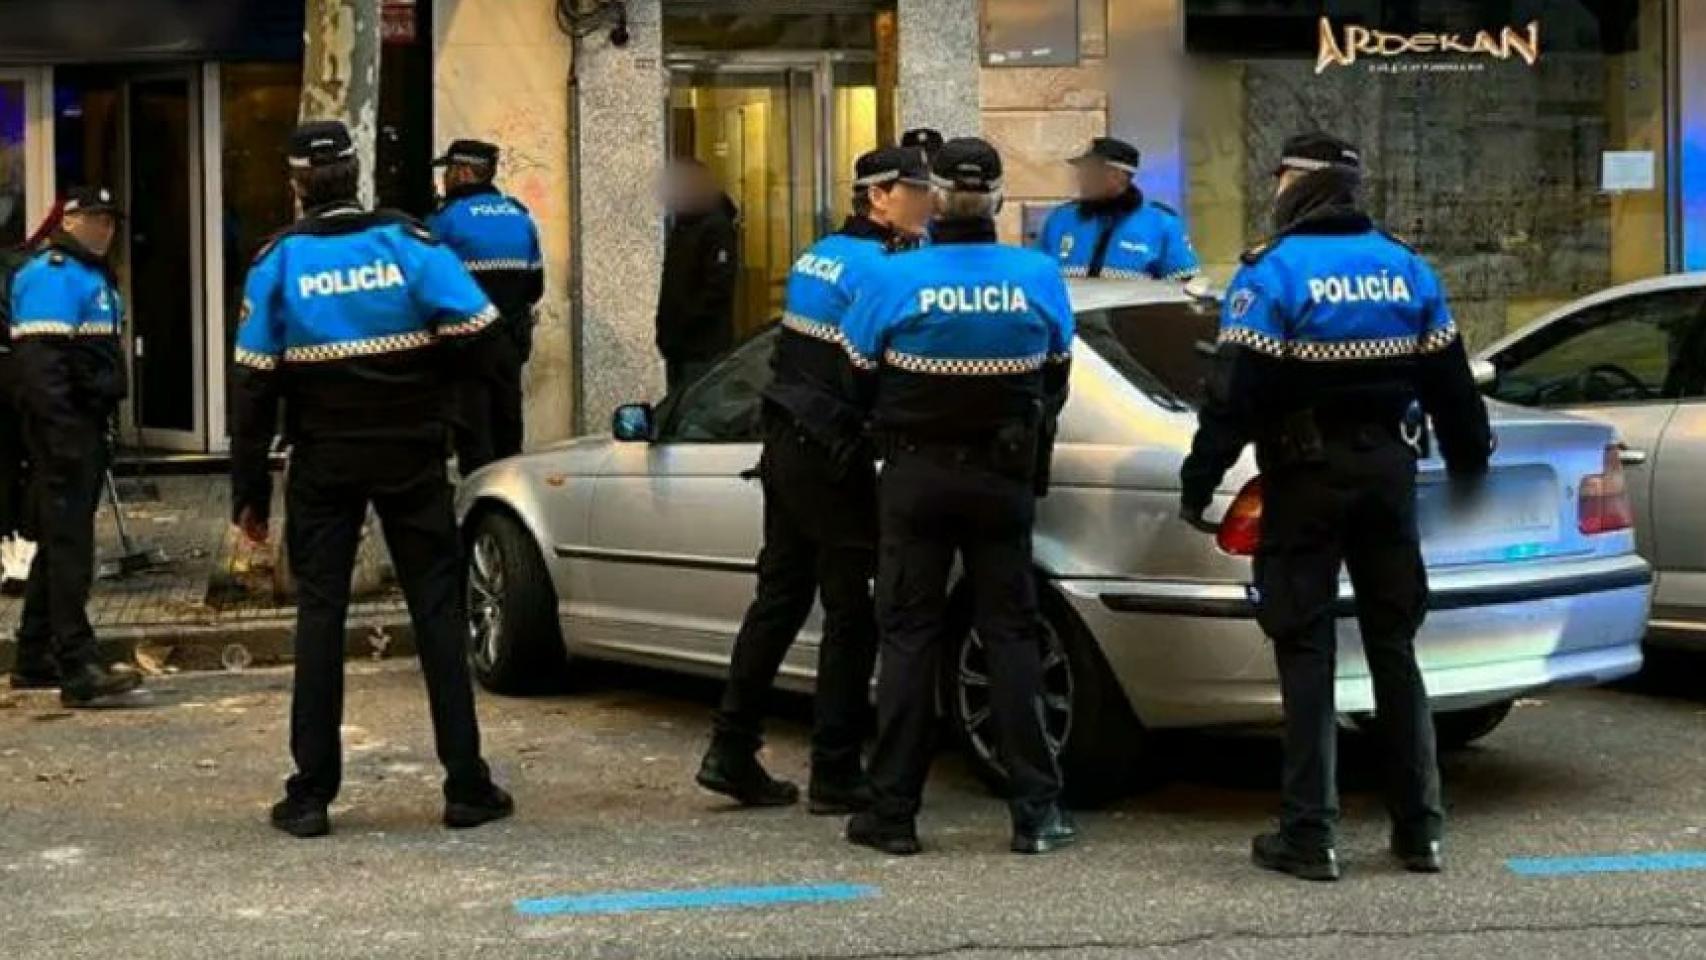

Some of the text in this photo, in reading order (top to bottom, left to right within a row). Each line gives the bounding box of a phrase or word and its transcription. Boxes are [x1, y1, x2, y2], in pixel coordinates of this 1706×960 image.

[1315, 16, 1539, 74] ARDEKAN
[298, 259, 405, 298] POLICÍA
[1308, 269, 1411, 303] POLICÍA
[919, 282, 1029, 313] POLICÍA
